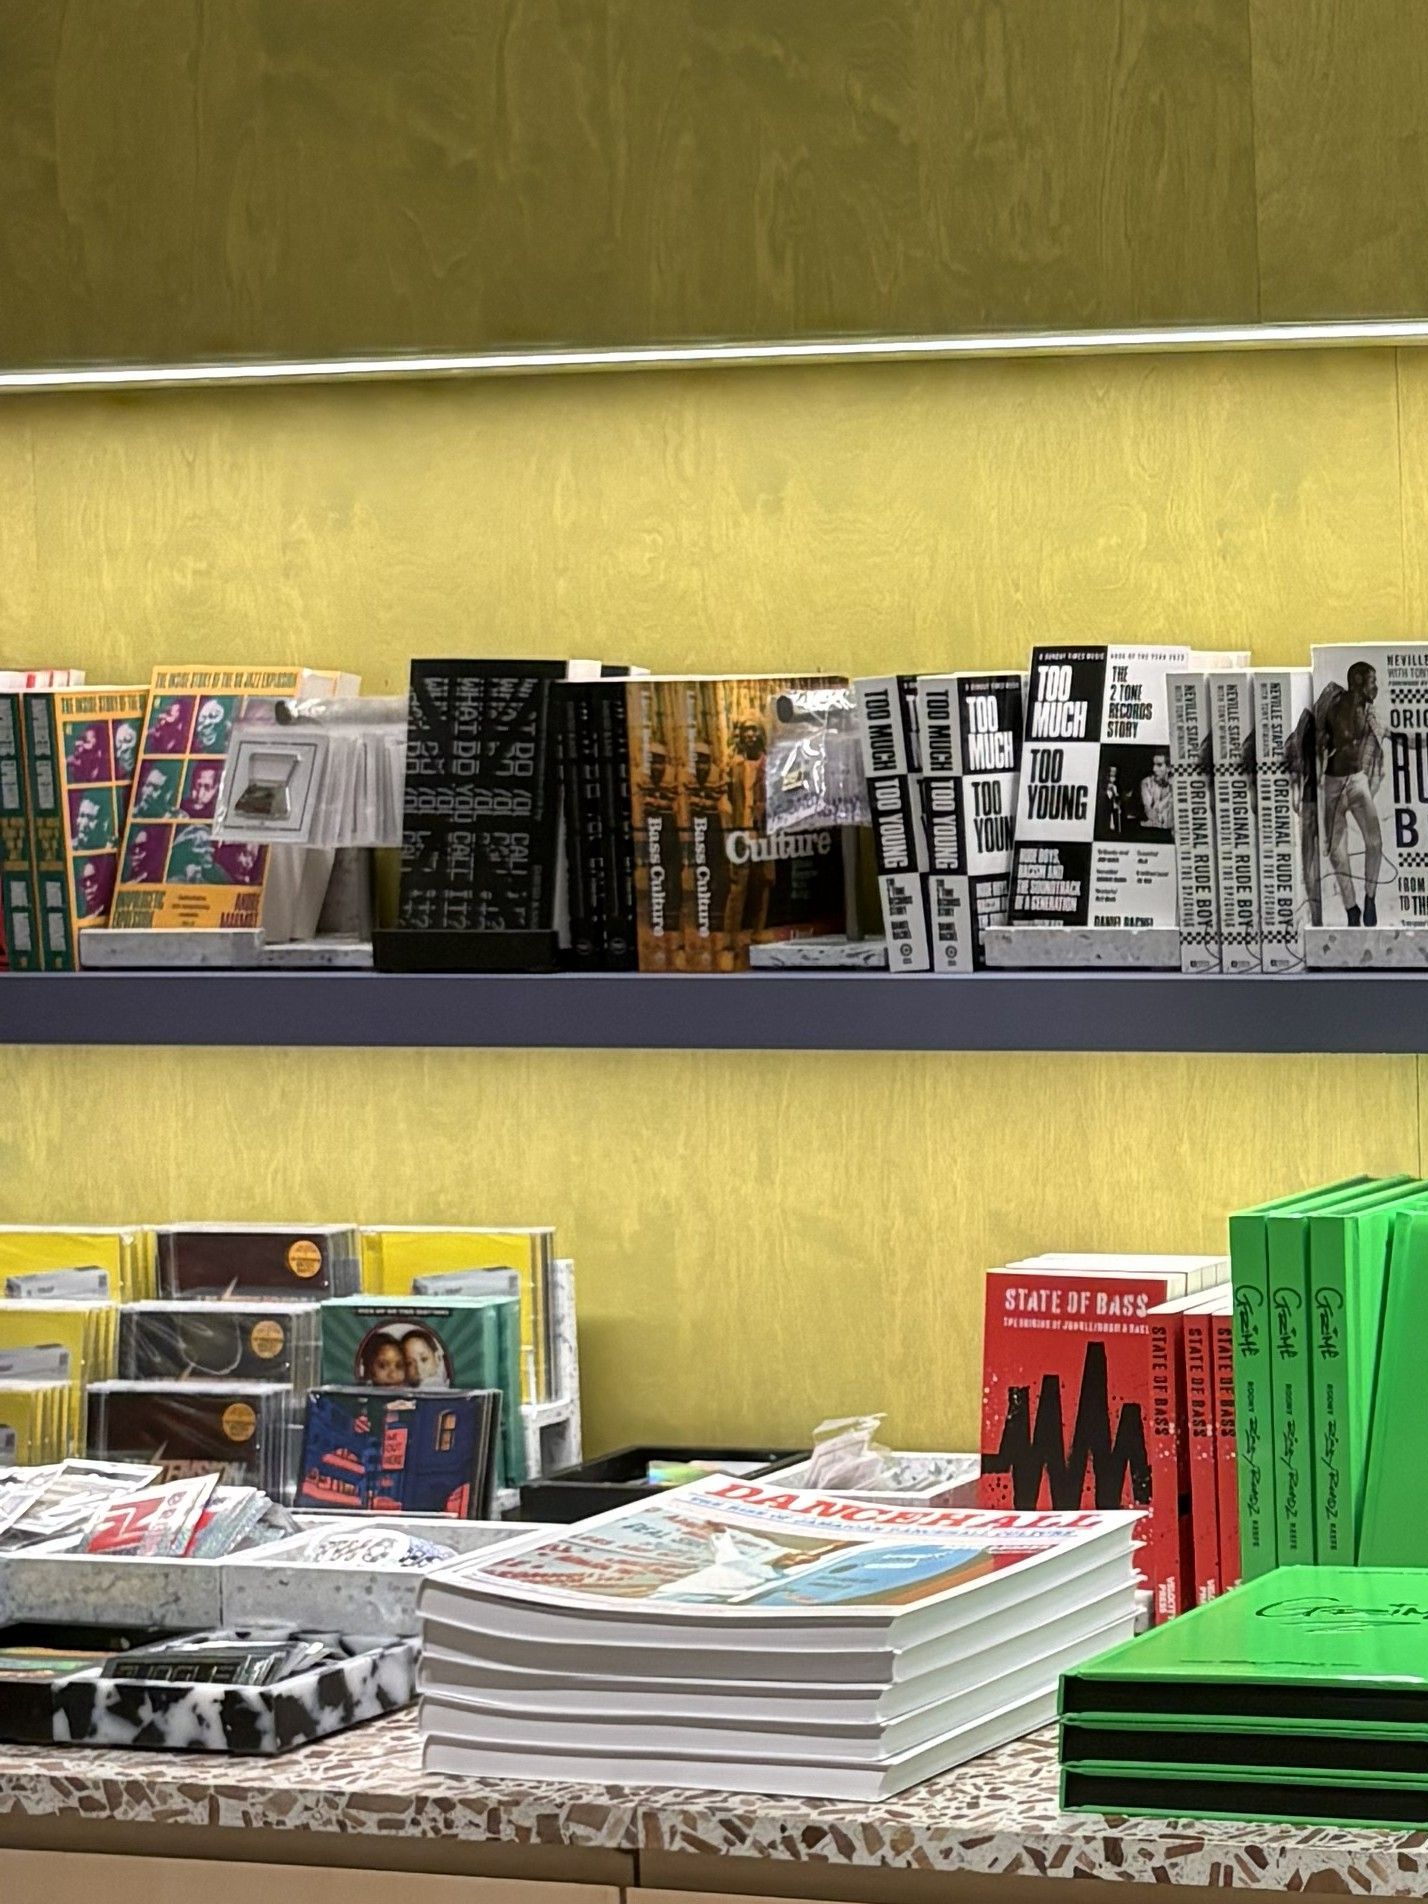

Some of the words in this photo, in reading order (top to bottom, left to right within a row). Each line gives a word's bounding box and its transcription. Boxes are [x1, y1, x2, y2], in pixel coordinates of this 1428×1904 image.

[1111, 666, 1127, 683] THE
[1387, 654, 1428, 666] NEVILLE
[1037, 665, 1073, 702] TOO
[1110, 684, 1117, 700] 2
[1119, 684, 1142, 701] TONE
[1031, 701, 1088, 738] MUCH
[1108, 703, 1153, 720] RECORDS
[1107, 721, 1138, 738] STORY
[1030, 749, 1064, 783] TOO
[1027, 785, 1088, 820] YOUNG
[648, 817, 662, 864] Bass
[725, 830, 832, 865] Culture
[1398, 876, 1425, 892] FROM
[650, 866, 665, 937] Culture
[1400, 896, 1410, 911] TO
[1005, 1288, 1062, 1314] STATE
[1067, 1290, 1090, 1315] OF
[1096, 1292, 1149, 1318] BASS
[703, 1483, 1103, 1530] DANCEHALL
